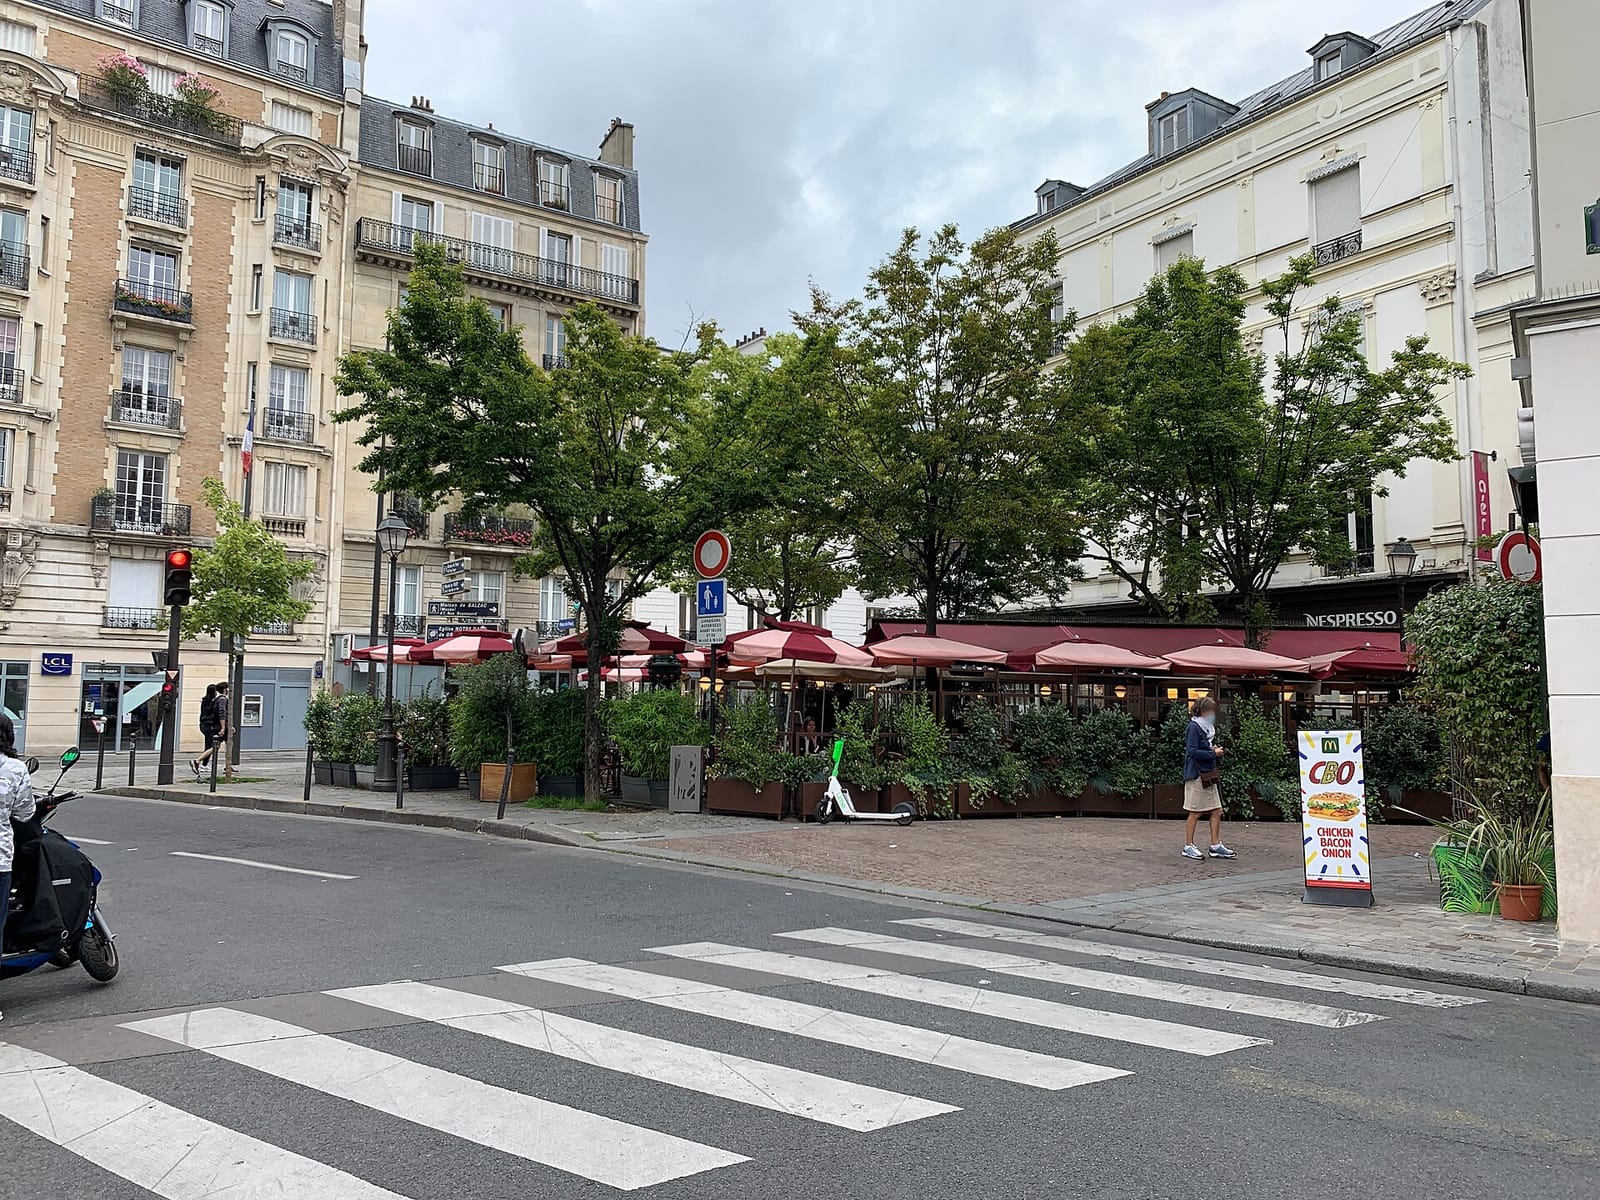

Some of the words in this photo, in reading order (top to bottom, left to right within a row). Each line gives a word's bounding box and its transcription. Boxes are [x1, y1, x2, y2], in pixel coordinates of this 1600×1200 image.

[1303, 610, 1397, 627] NESPRESSO
[44, 658, 70, 666] LCL
[1308, 760, 1356, 786] CBO
[1317, 827, 1354, 838] CHICKEN
[1320, 838, 1352, 848] BACON
[1322, 848, 1352, 858] ONION
